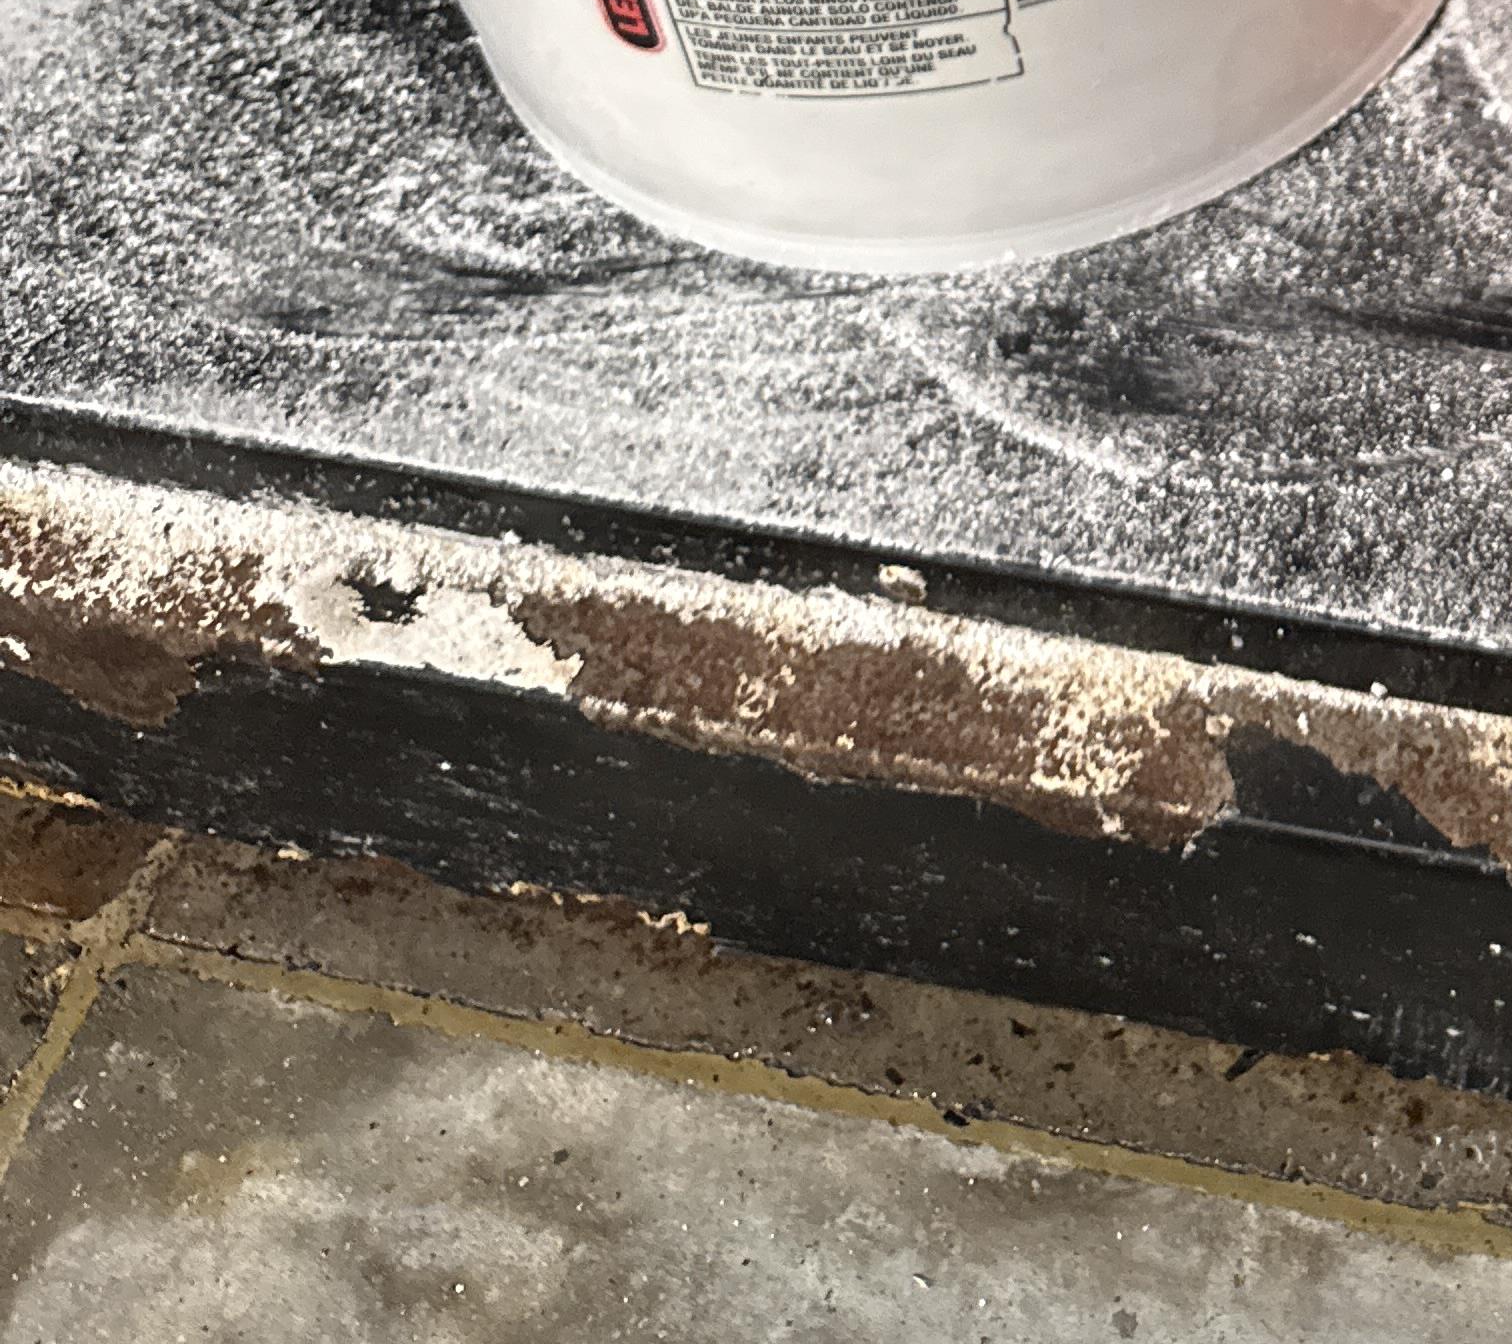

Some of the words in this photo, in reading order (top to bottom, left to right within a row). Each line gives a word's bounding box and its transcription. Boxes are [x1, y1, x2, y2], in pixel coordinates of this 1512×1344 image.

[706, 0, 754, 14] BALDE
[760, 4, 823, 16] AUNQUE
[827, 3, 870, 15] SOLO
[788, 14, 867, 27] CANTIDAD
[870, 13, 890, 24] DE
[849, 29, 918, 44] PEUVENT
[800, 45, 817, 55] LE
[822, 45, 862, 55] SEAU
[866, 43, 882, 54] ET
[888, 41, 909, 53] SE
[871, 54, 907, 66] LOIN
[911, 51, 934, 62] DU
[937, 43, 977, 60] SEAU
[799, 68, 873, 79] CONTIENT
